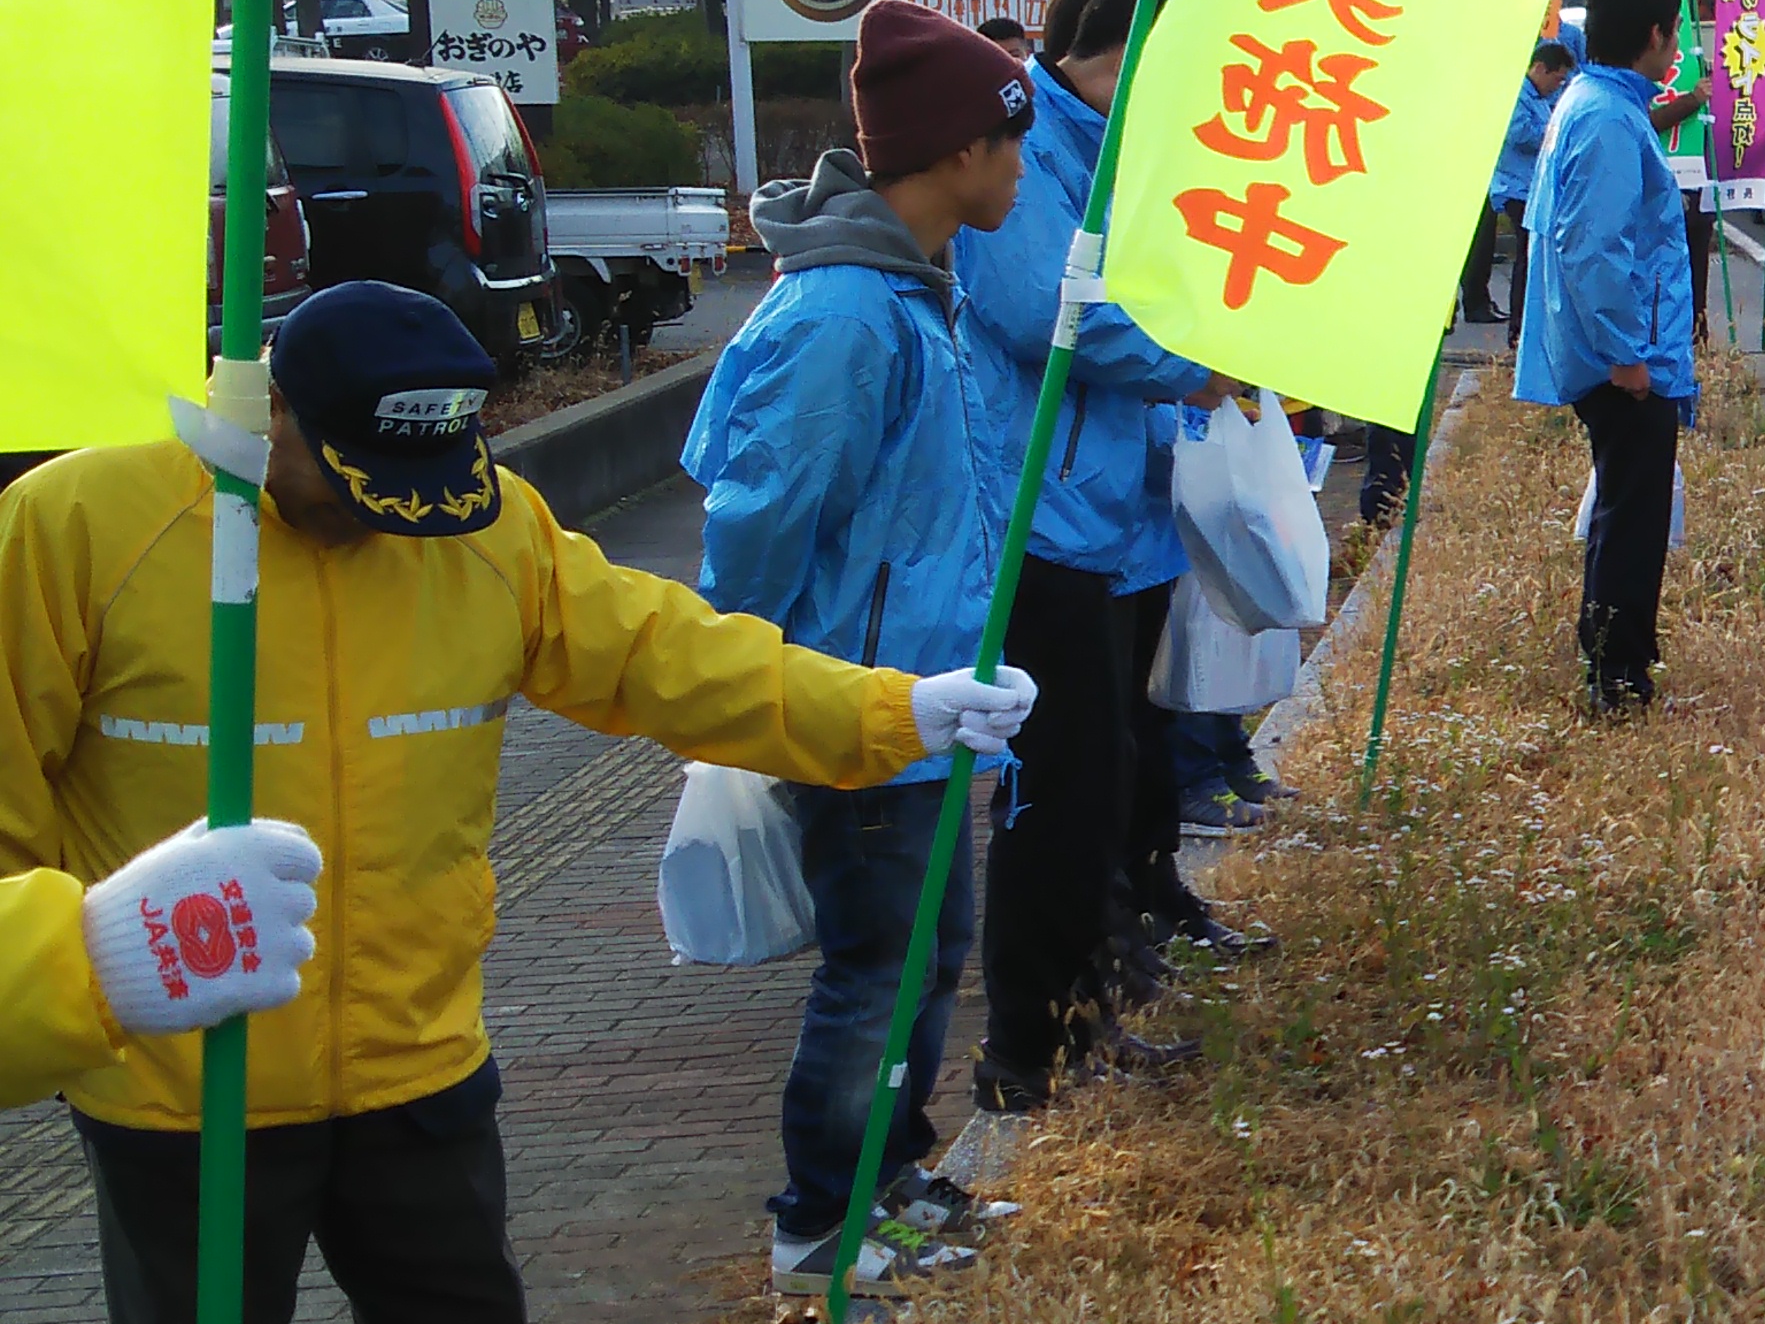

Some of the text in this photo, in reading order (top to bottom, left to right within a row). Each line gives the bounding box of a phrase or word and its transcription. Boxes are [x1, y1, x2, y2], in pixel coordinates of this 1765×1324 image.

[437, 31, 547, 62] おぎのや
[391, 396, 478, 416] SAFETY
[378, 416, 469, 436] PATROL
